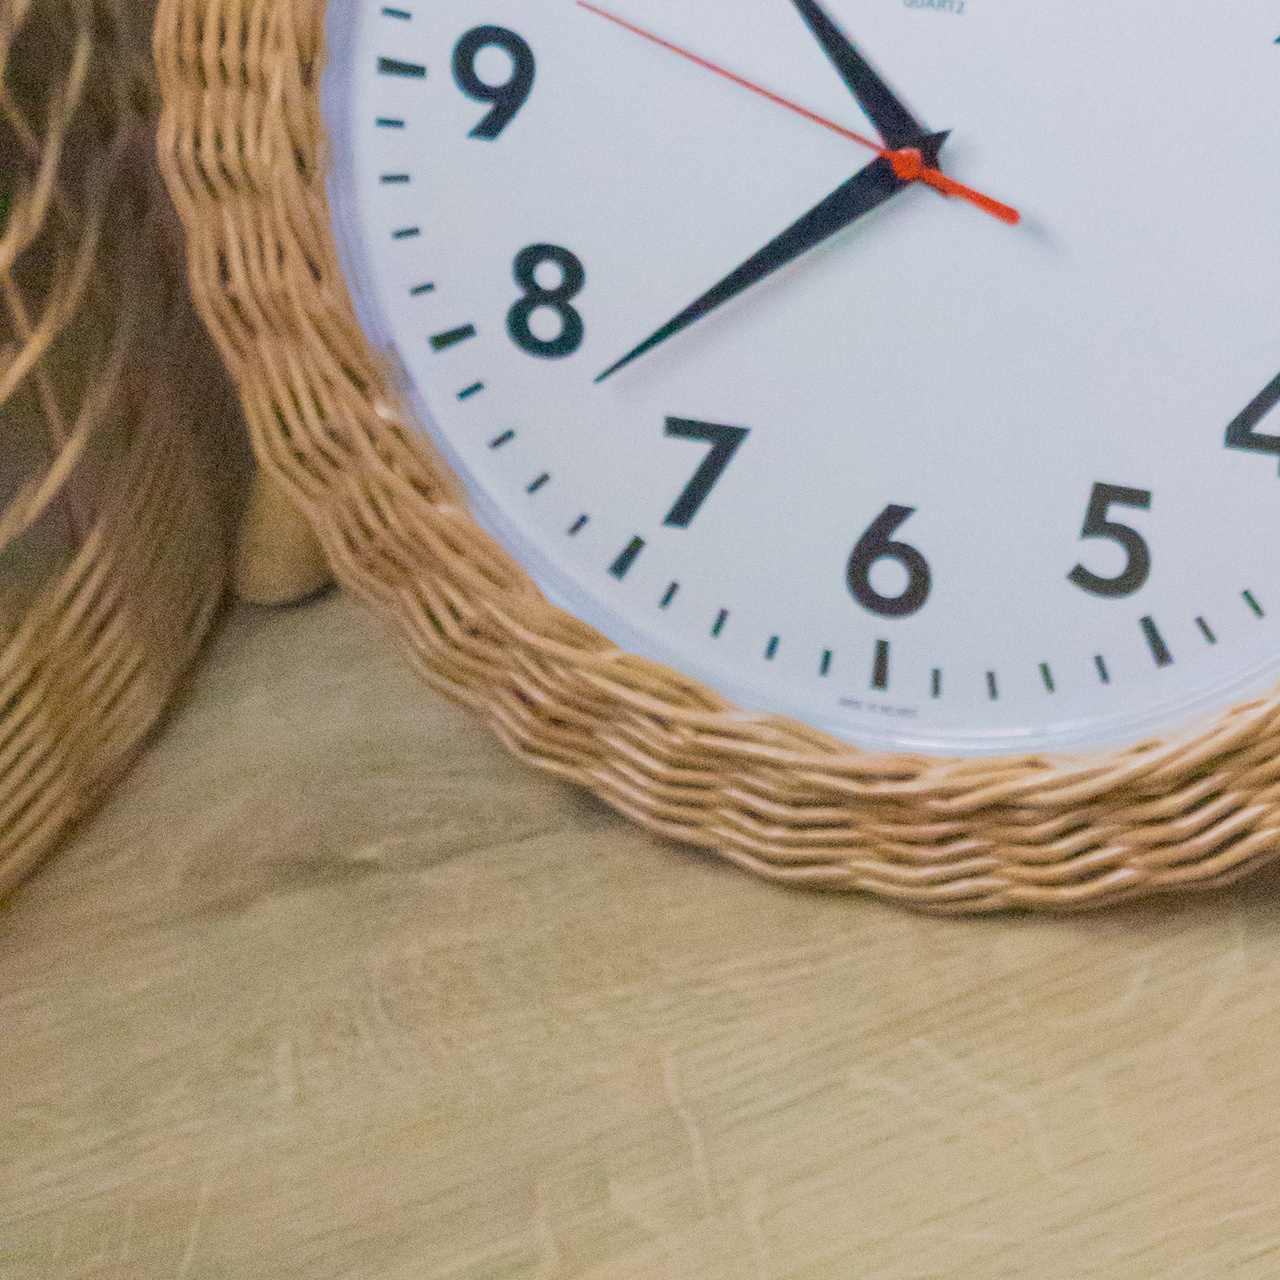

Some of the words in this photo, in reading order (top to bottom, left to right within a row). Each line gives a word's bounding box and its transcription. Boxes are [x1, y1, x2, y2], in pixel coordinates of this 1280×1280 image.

[450, 24, 537, 142] 9
[505, 242, 587, 361] 8
[662, 415, 751, 529] 7
[845, 503, 933, 620] 6
[1066, 481, 1152, 599] 5
